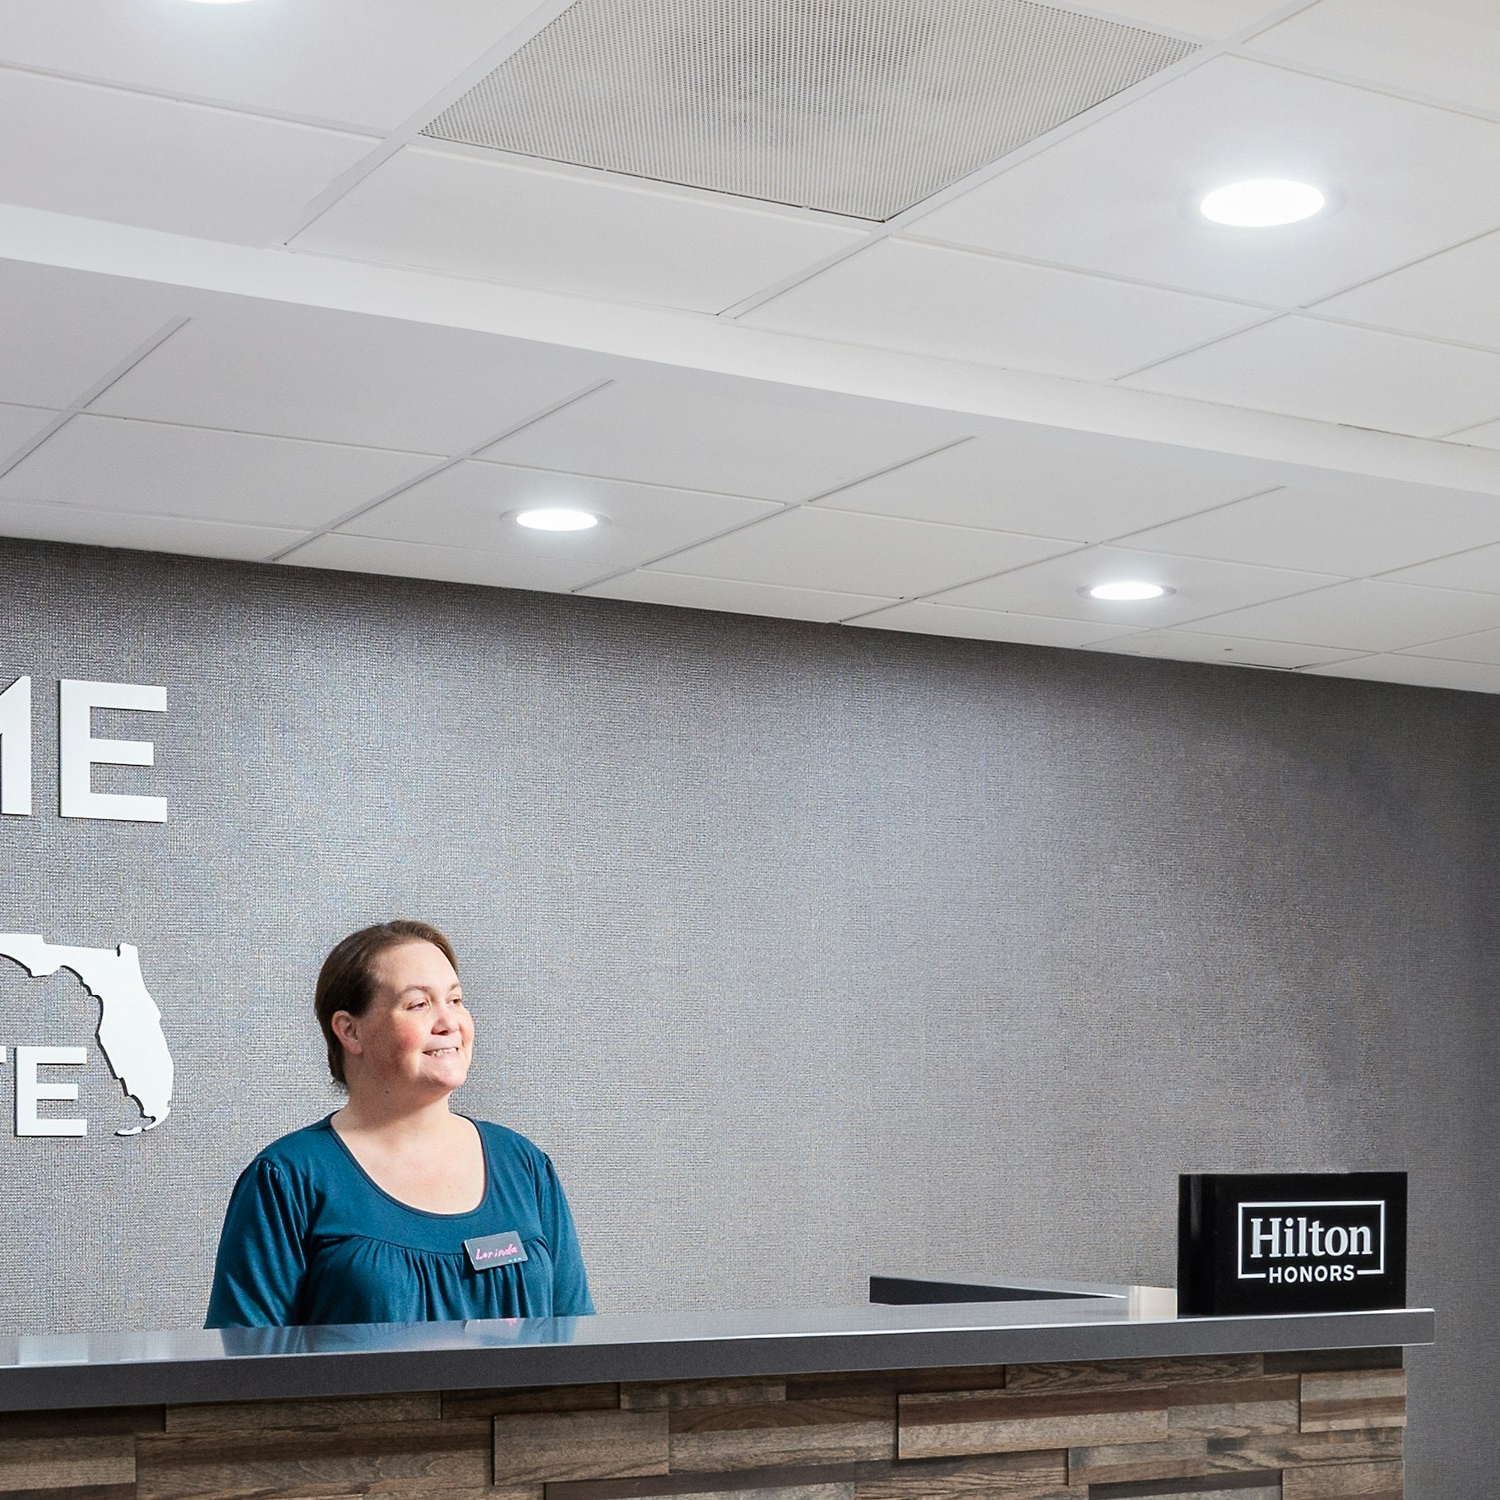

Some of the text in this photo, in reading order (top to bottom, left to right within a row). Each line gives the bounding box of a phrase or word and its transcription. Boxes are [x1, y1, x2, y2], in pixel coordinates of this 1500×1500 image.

[1250, 1217, 1373, 1259] Hilton
[475, 1243, 518, 1261] Lorinda
[1268, 1264, 1356, 1284] HONORS
